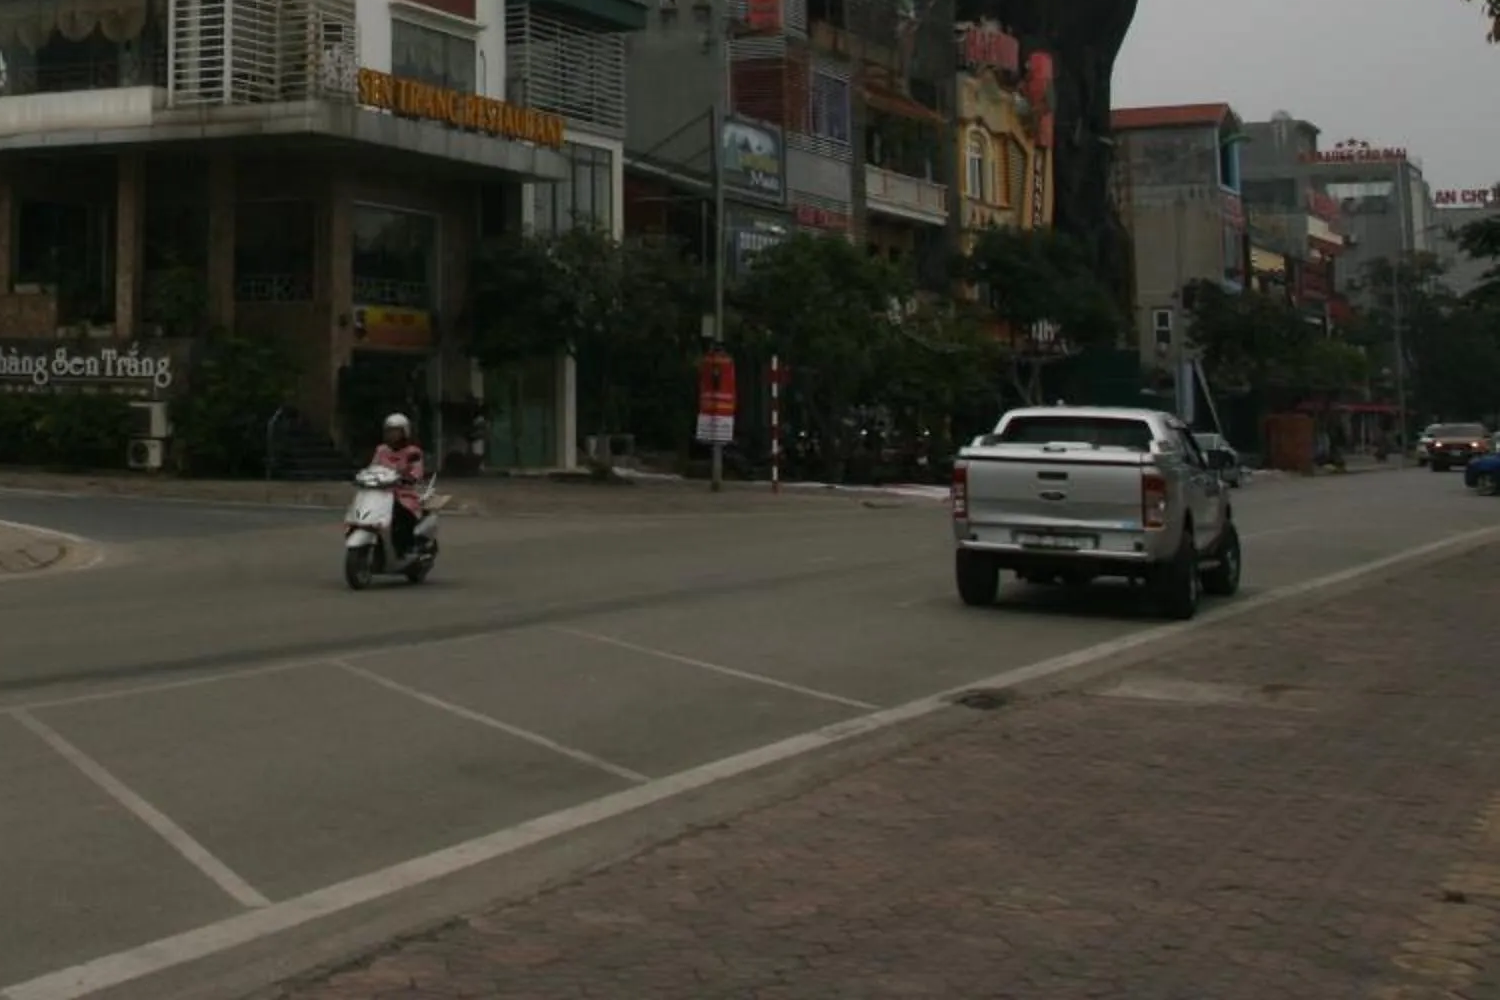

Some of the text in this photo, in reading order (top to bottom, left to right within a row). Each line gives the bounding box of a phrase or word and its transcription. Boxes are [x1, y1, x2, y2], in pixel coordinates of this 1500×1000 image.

[357, 67, 393, 105] SEN
[463, 94, 565, 147] RESTAURANT
[51, 347, 100, 376] Sen
